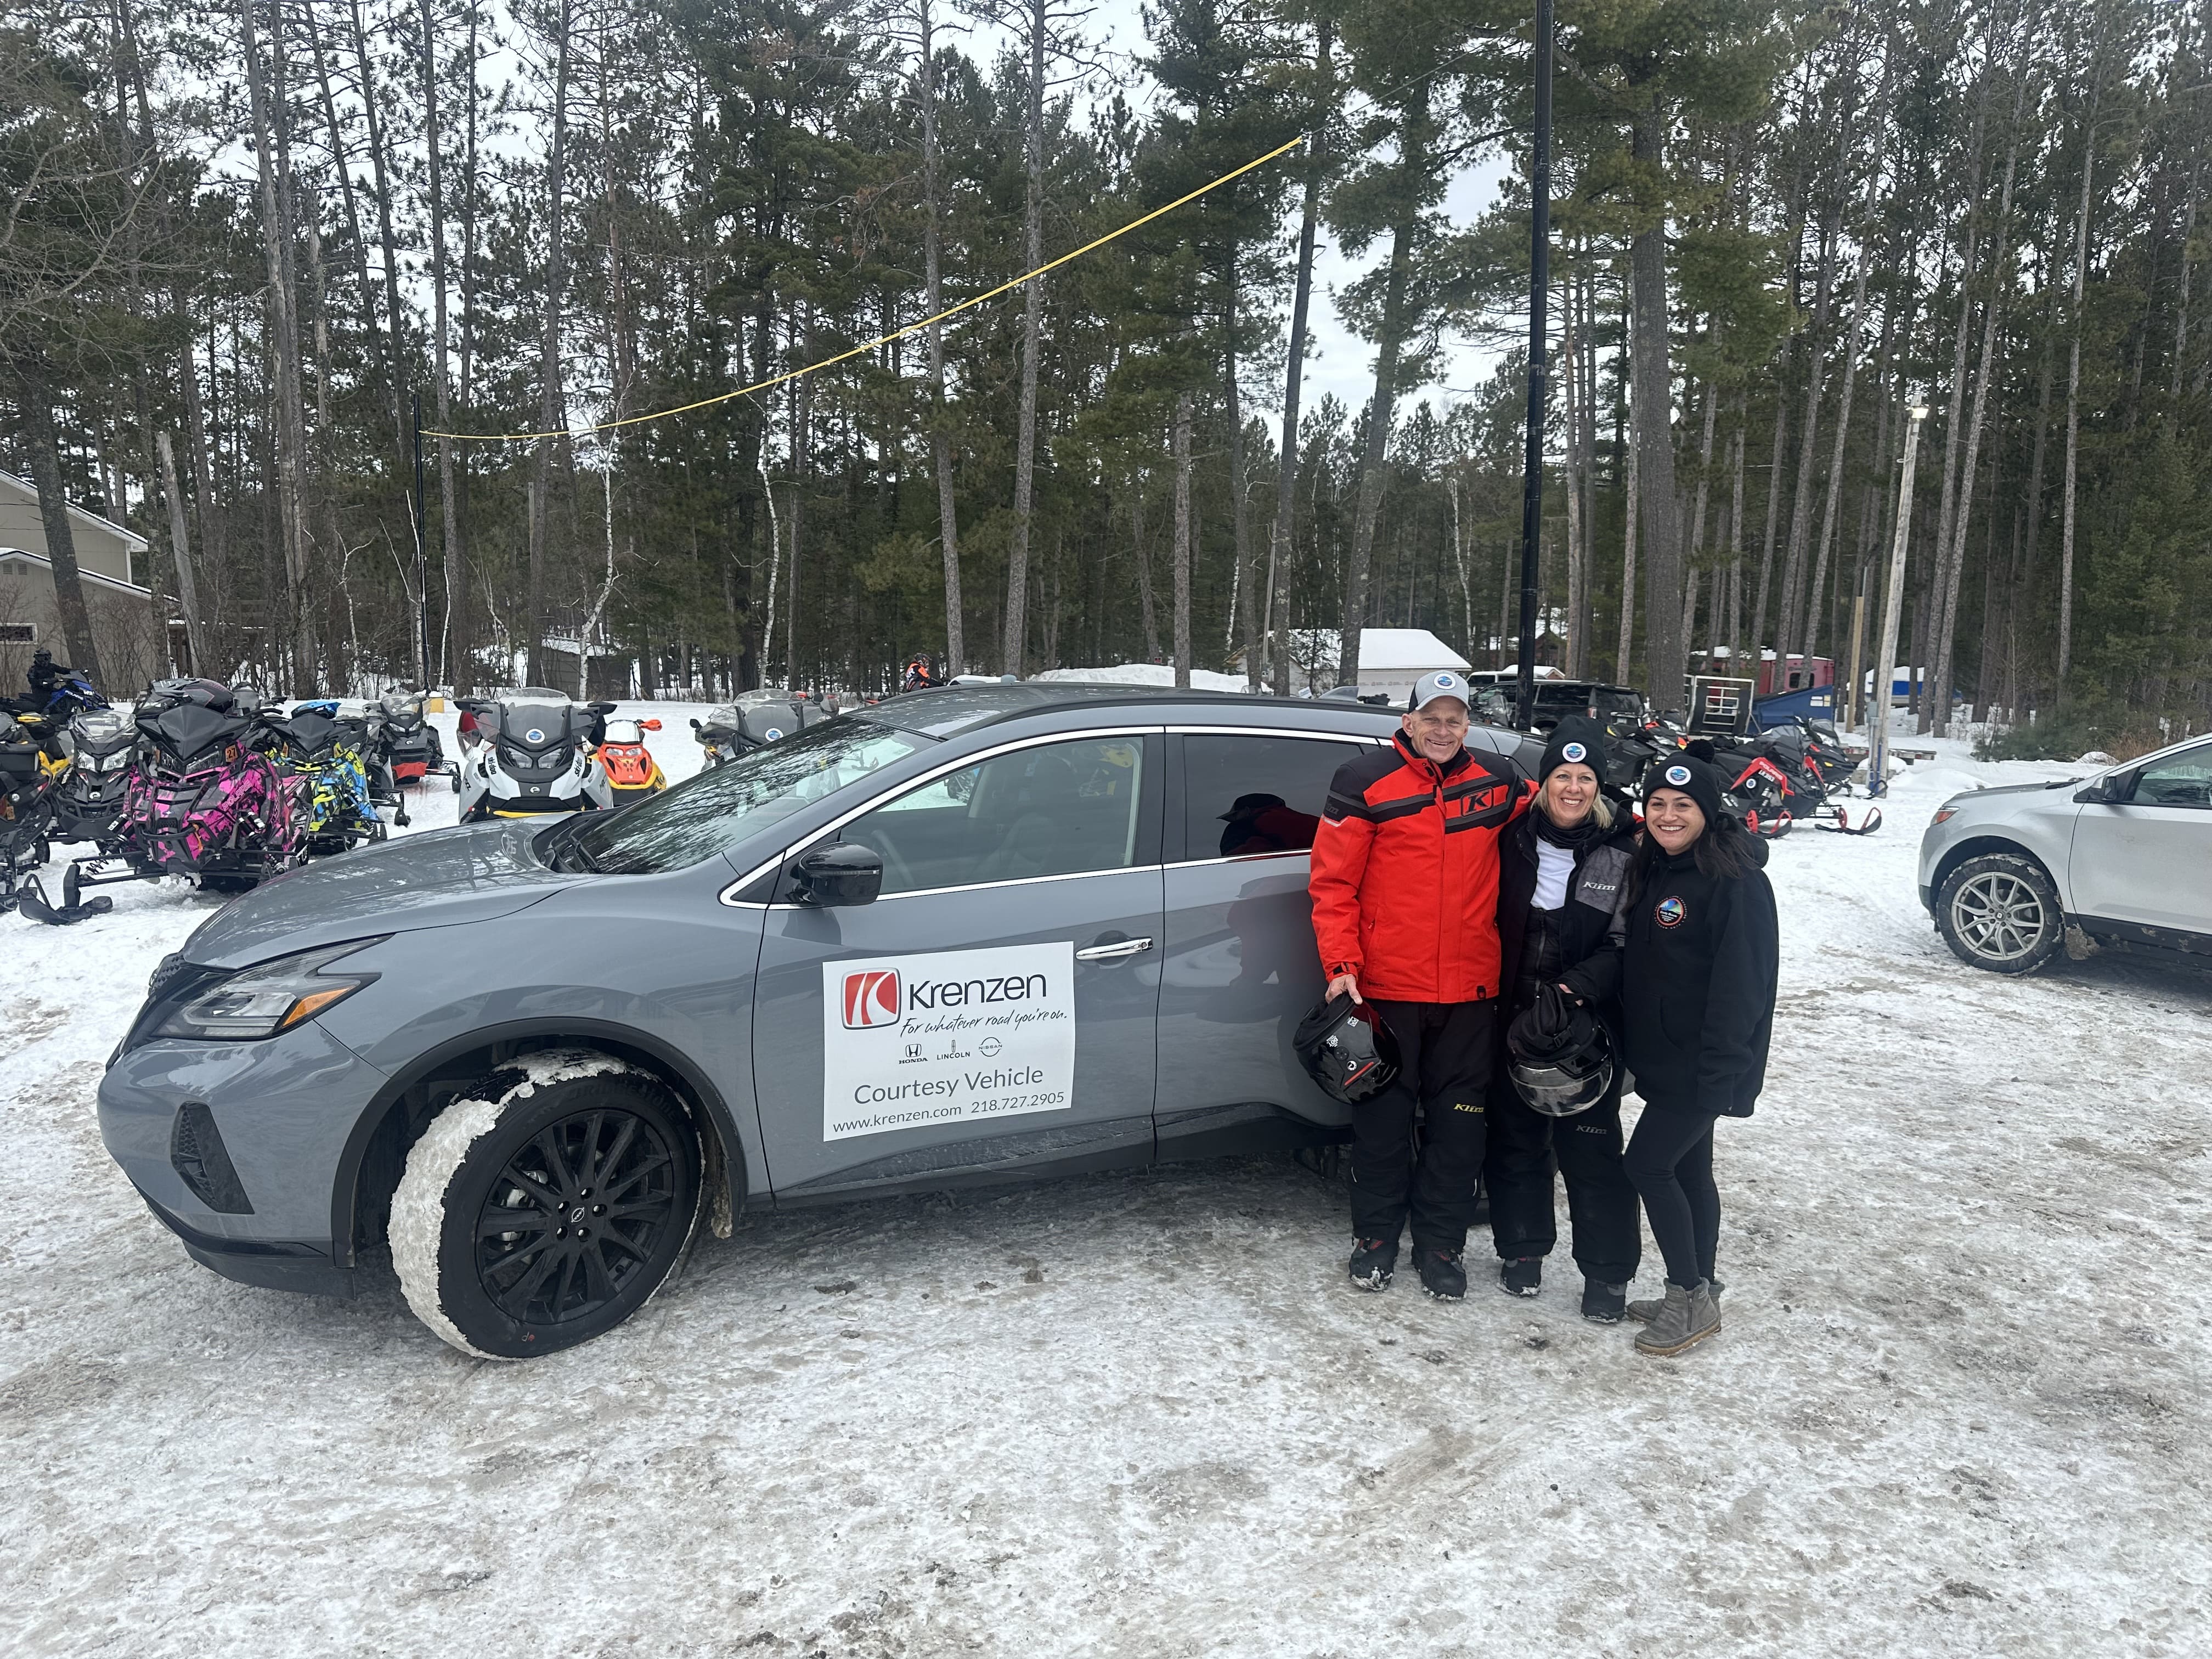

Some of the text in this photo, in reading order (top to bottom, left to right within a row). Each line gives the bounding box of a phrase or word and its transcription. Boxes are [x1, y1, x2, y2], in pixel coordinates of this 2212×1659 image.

[909, 973, 1047, 1011] Krenzen
[900, 1008, 1068, 1038] For whatever road you're on.
[936, 1051, 970, 1060] LINCOLN
[854, 1066, 1043, 1104] Courtesy Vehicle
[833, 1091, 1064, 1133] www.krenzen.com 218.727.2905
